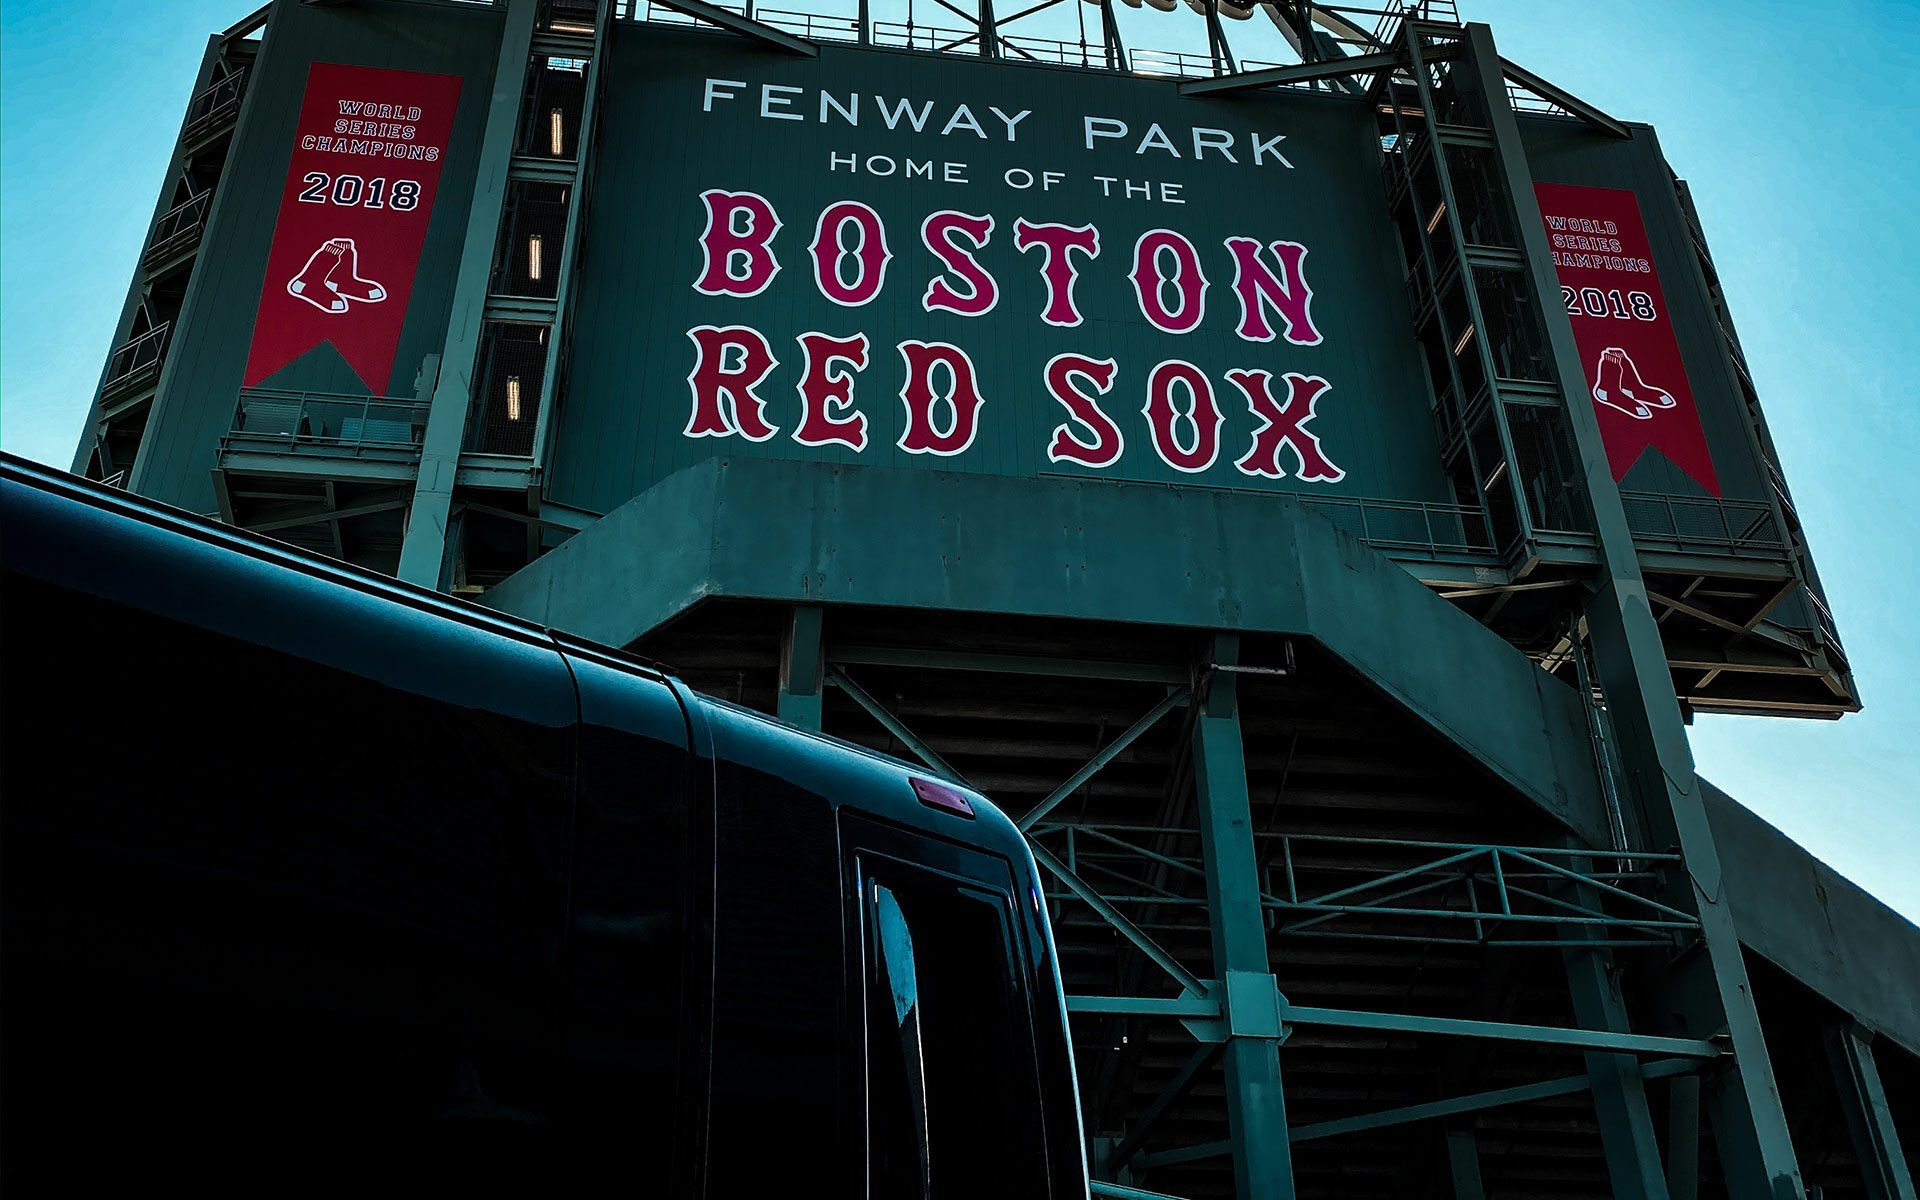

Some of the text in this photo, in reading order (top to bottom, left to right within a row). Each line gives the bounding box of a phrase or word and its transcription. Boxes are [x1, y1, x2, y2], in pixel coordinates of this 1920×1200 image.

[337, 100, 422, 122] WORLD
[704, 78, 1295, 169] FENWAY PARK
[334, 118, 416, 141] SERIES
[301, 135, 440, 162] CHAMPIONS
[298, 171, 422, 212] 2018
[830, 151, 1186, 204] HOME OF THE
[1545, 215, 1618, 235] WORLD
[1552, 233, 1622, 253] SERIES
[692, 188, 1324, 346] BOSTON
[1552, 251, 1651, 273] HAMPIONS
[1560, 285, 1657, 321] 2018
[682, 324, 1347, 484] RED SOX
